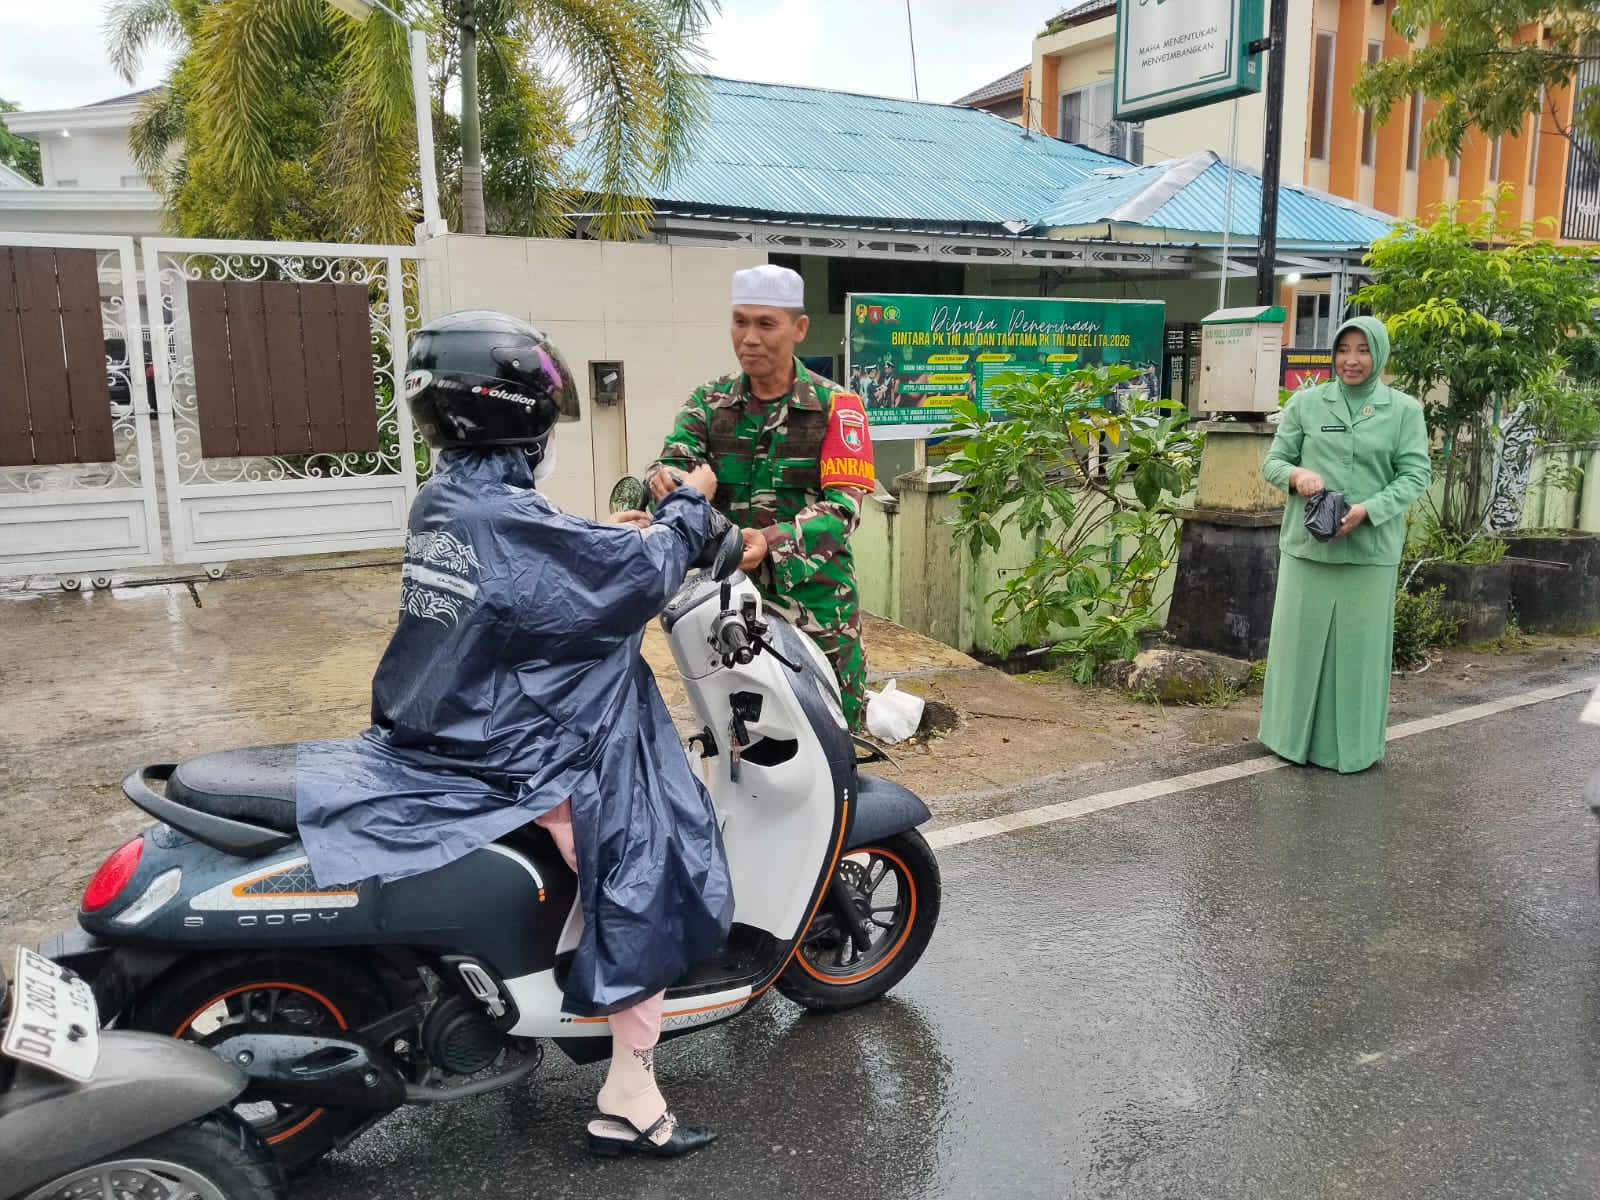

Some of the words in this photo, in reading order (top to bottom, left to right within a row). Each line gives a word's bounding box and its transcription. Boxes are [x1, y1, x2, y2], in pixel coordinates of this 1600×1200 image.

[1162, 25, 1218, 48] MENENTUKAN
[930, 305, 998, 336] Dibuka
[1007, 308, 1101, 337] Penerimaan
[891, 331, 930, 345] BINTARA
[932, 332, 944, 346] PK
[946, 332, 961, 346] TNI
[963, 332, 976, 346] AD
[977, 333, 995, 346] DAN
[997, 332, 1038, 346] TAMTAMA
[1039, 333, 1050, 346] PK
[1052, 333, 1065, 347] TNI
[1066, 333, 1077, 347] AD
[471, 384, 537, 407] evolution
[15, 1022, 57, 1058] DA
